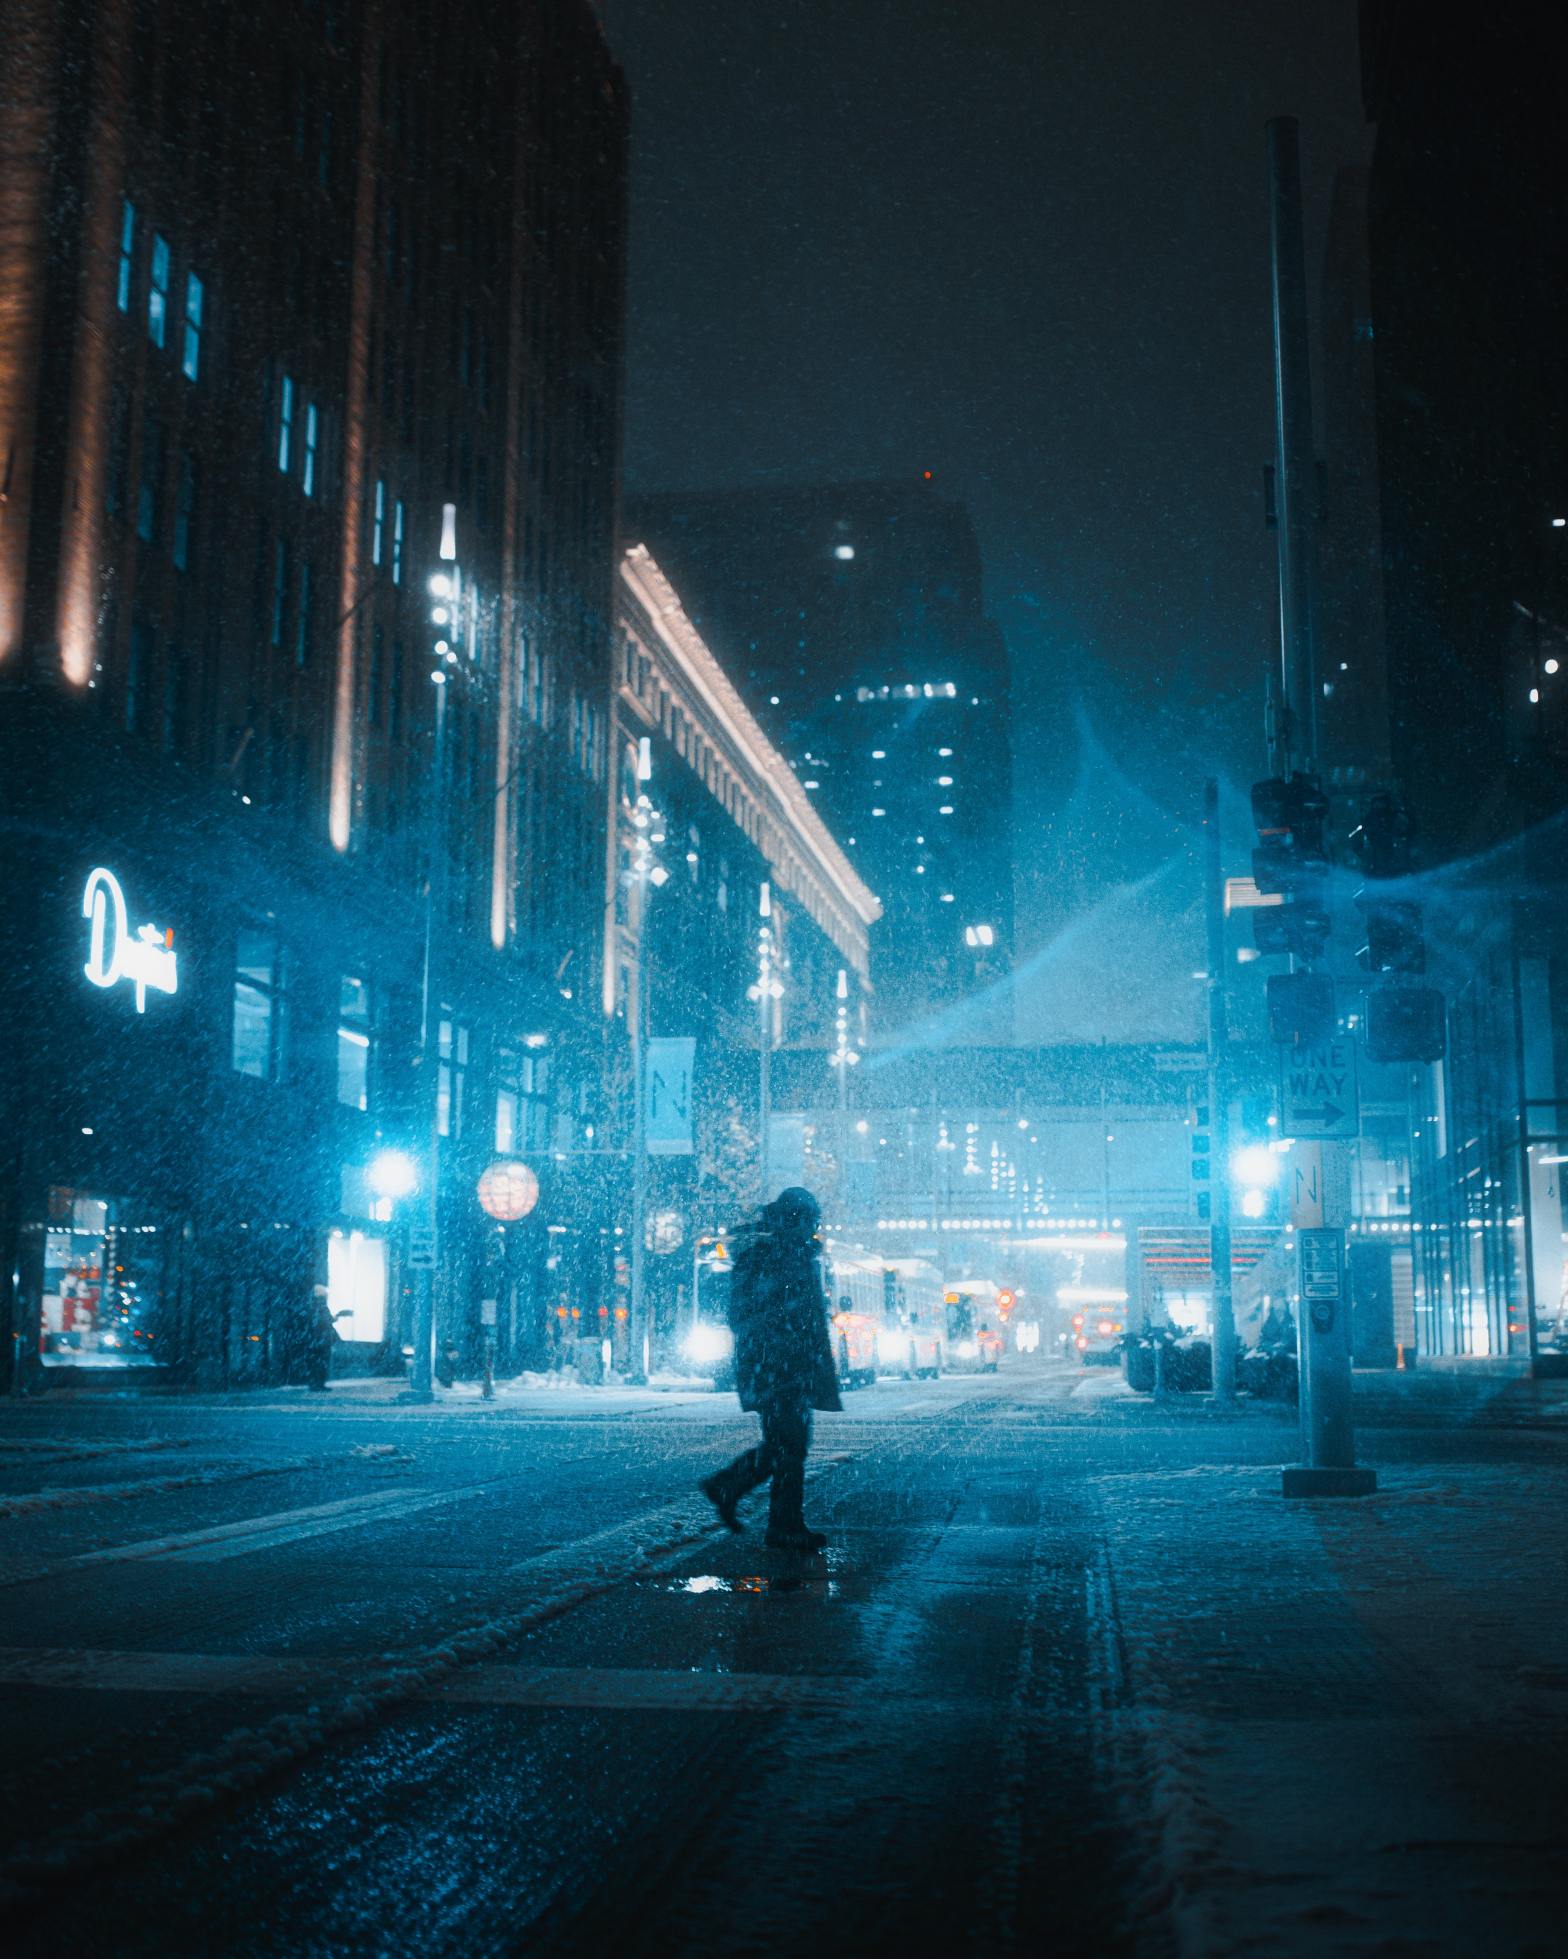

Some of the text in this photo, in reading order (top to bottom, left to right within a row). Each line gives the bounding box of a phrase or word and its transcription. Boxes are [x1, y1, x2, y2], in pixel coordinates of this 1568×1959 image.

[1290, 1045, 1346, 1068] ONE
[651, 1070, 686, 1119] N
[1289, 1072, 1348, 1096] WAY
[1295, 1165, 1317, 1204] N
